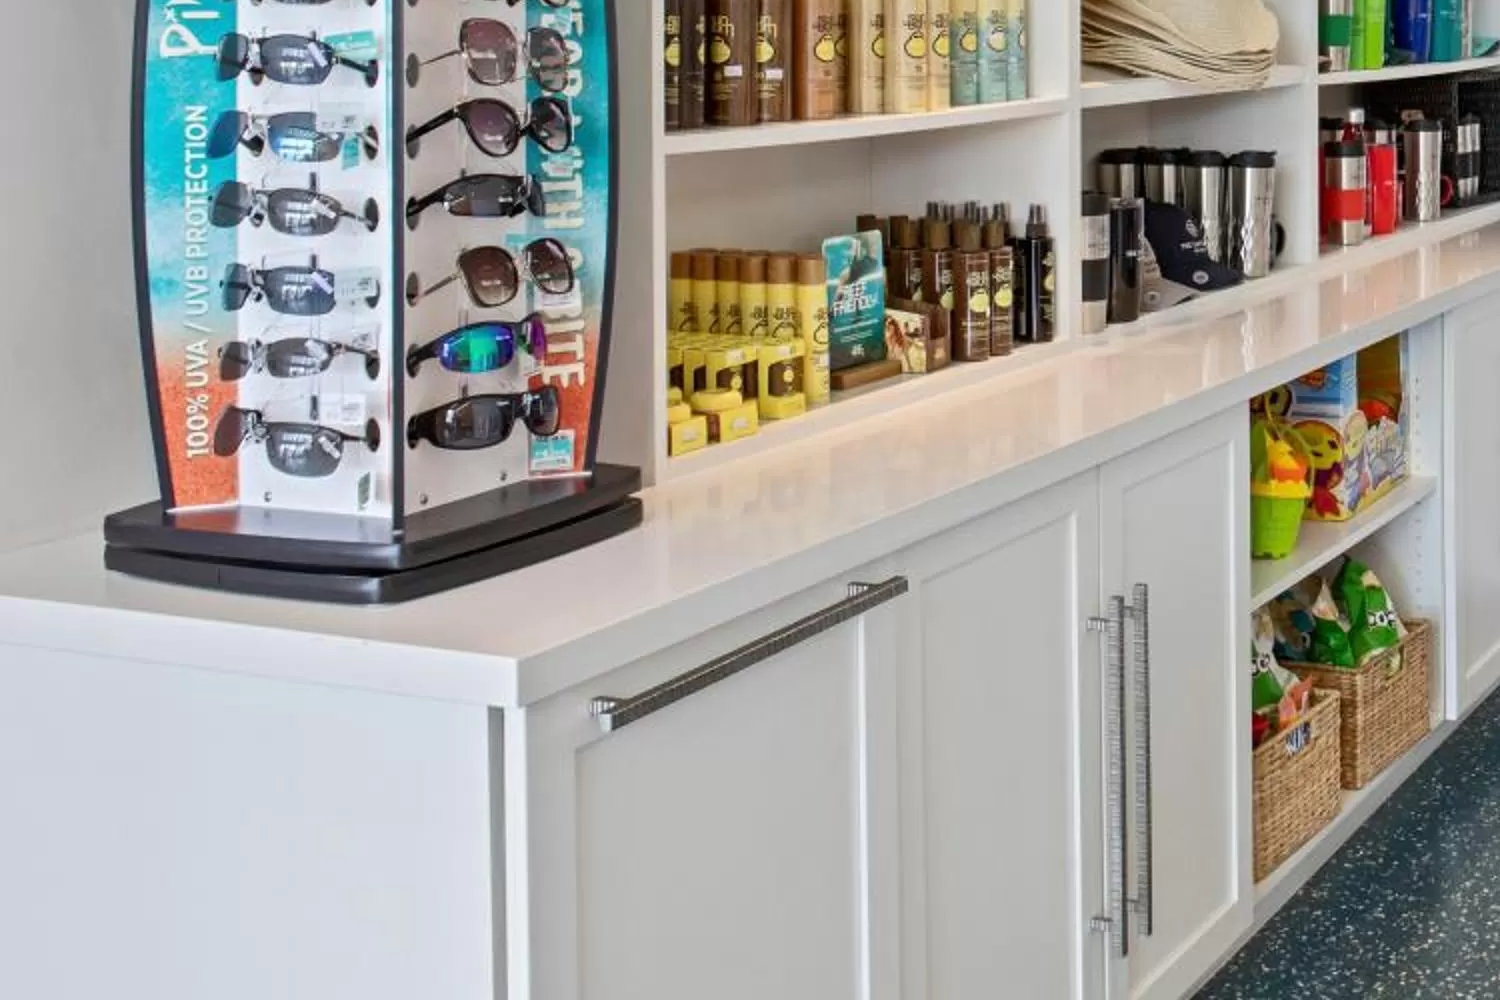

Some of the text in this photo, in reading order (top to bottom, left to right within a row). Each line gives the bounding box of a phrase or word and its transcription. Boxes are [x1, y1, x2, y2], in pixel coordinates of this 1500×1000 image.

[183, 104, 209, 260] PROTECTION
[184, 265, 209, 317] UVB
[185, 339, 209, 389] UVA
[185, 393, 209, 458] 100%
